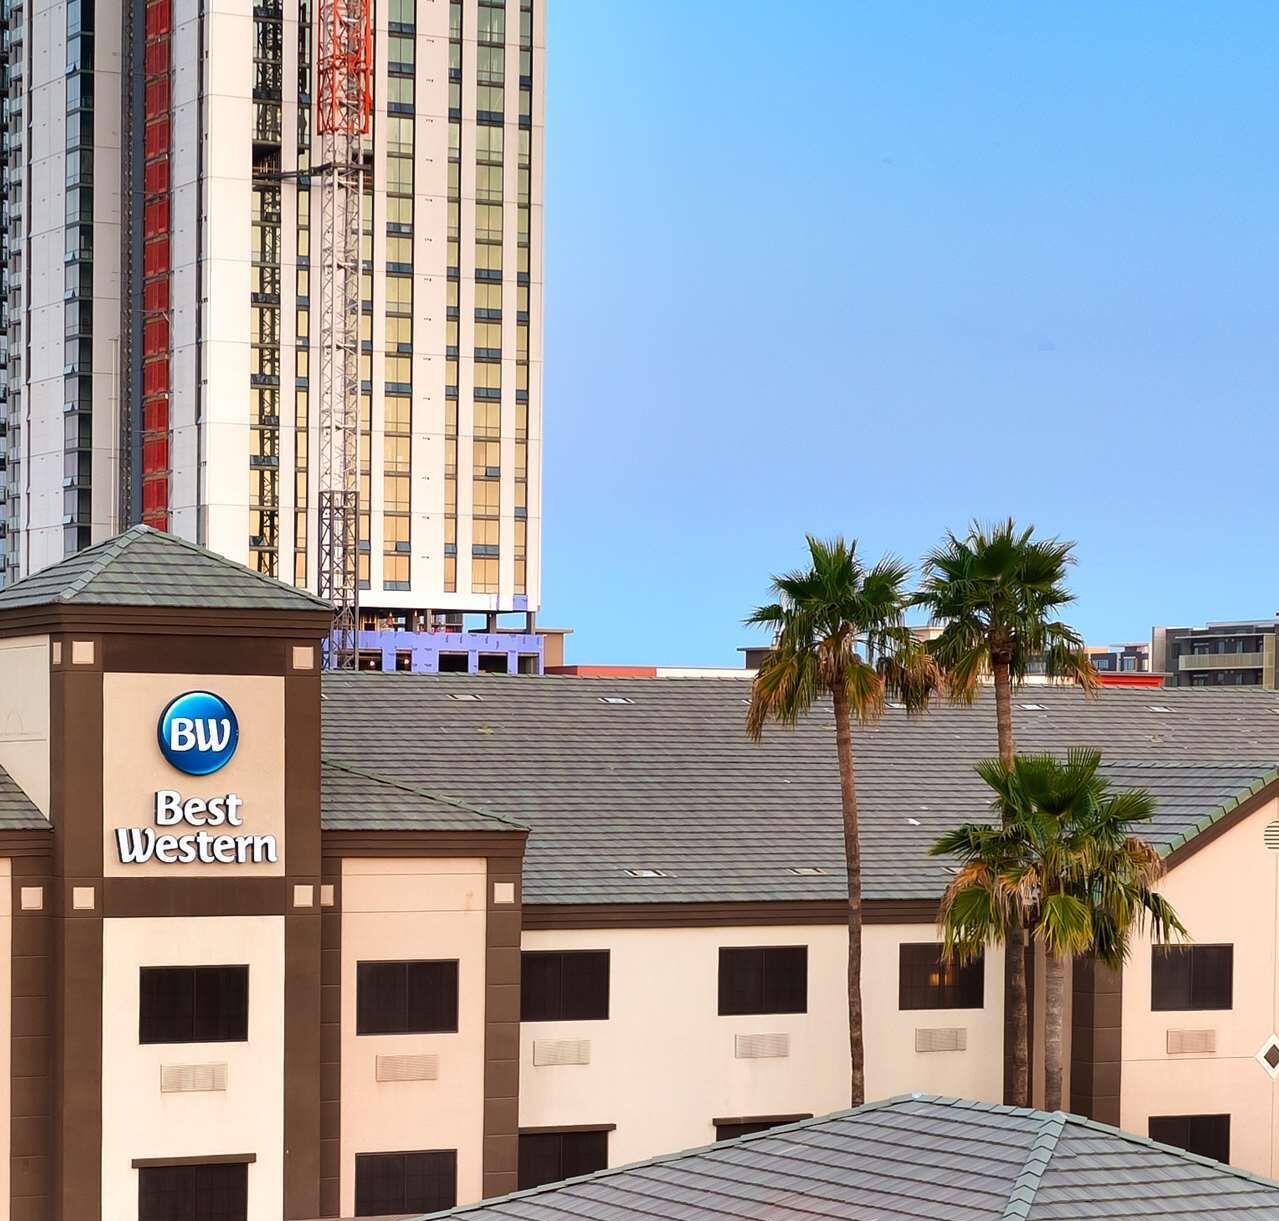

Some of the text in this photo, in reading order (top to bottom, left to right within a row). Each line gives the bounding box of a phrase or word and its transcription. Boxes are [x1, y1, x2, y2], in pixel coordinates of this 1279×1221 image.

[170, 717, 231, 752] BW
[155, 790, 243, 826] Best
[115, 828, 278, 863] Western
